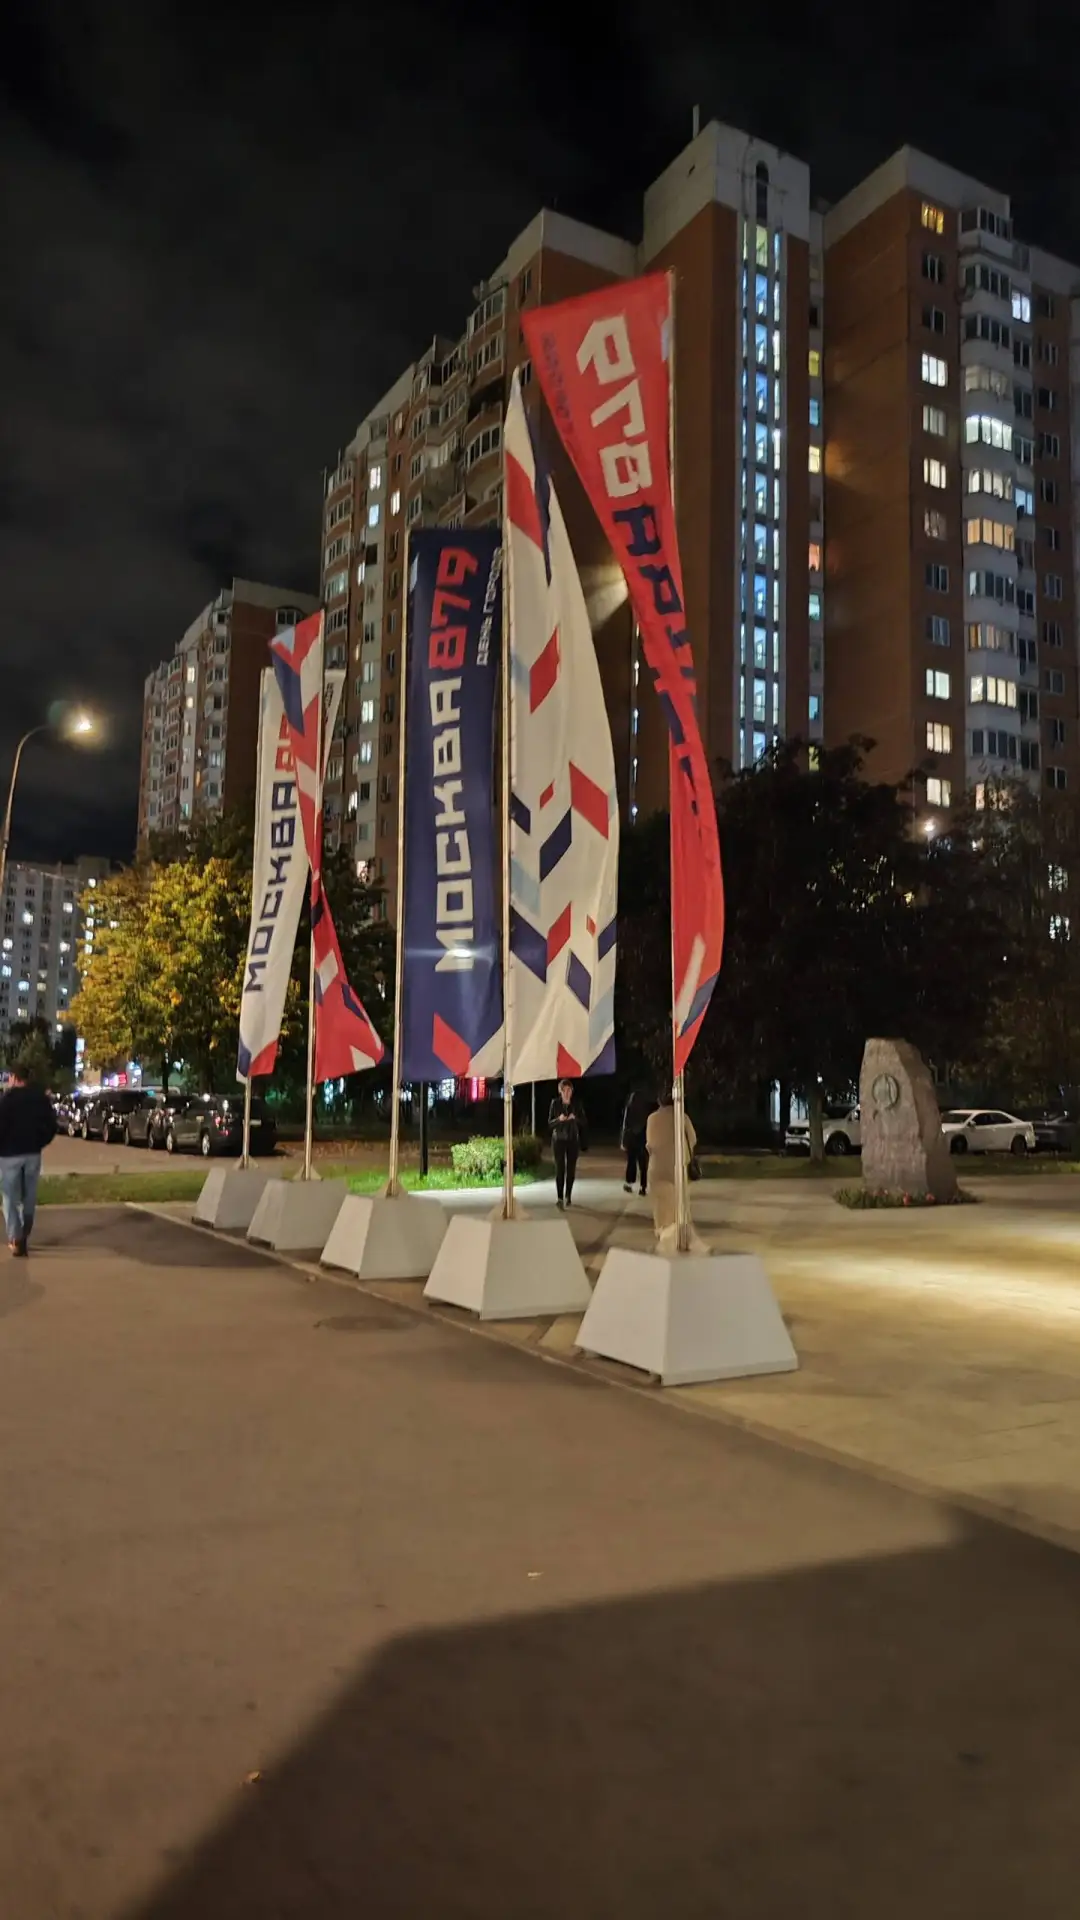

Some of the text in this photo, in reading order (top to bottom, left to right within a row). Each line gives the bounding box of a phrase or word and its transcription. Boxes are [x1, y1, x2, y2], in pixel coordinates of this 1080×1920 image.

[244, 779, 297, 993] МОСКВА
[429, 546, 479, 972] МОСКВА 879
